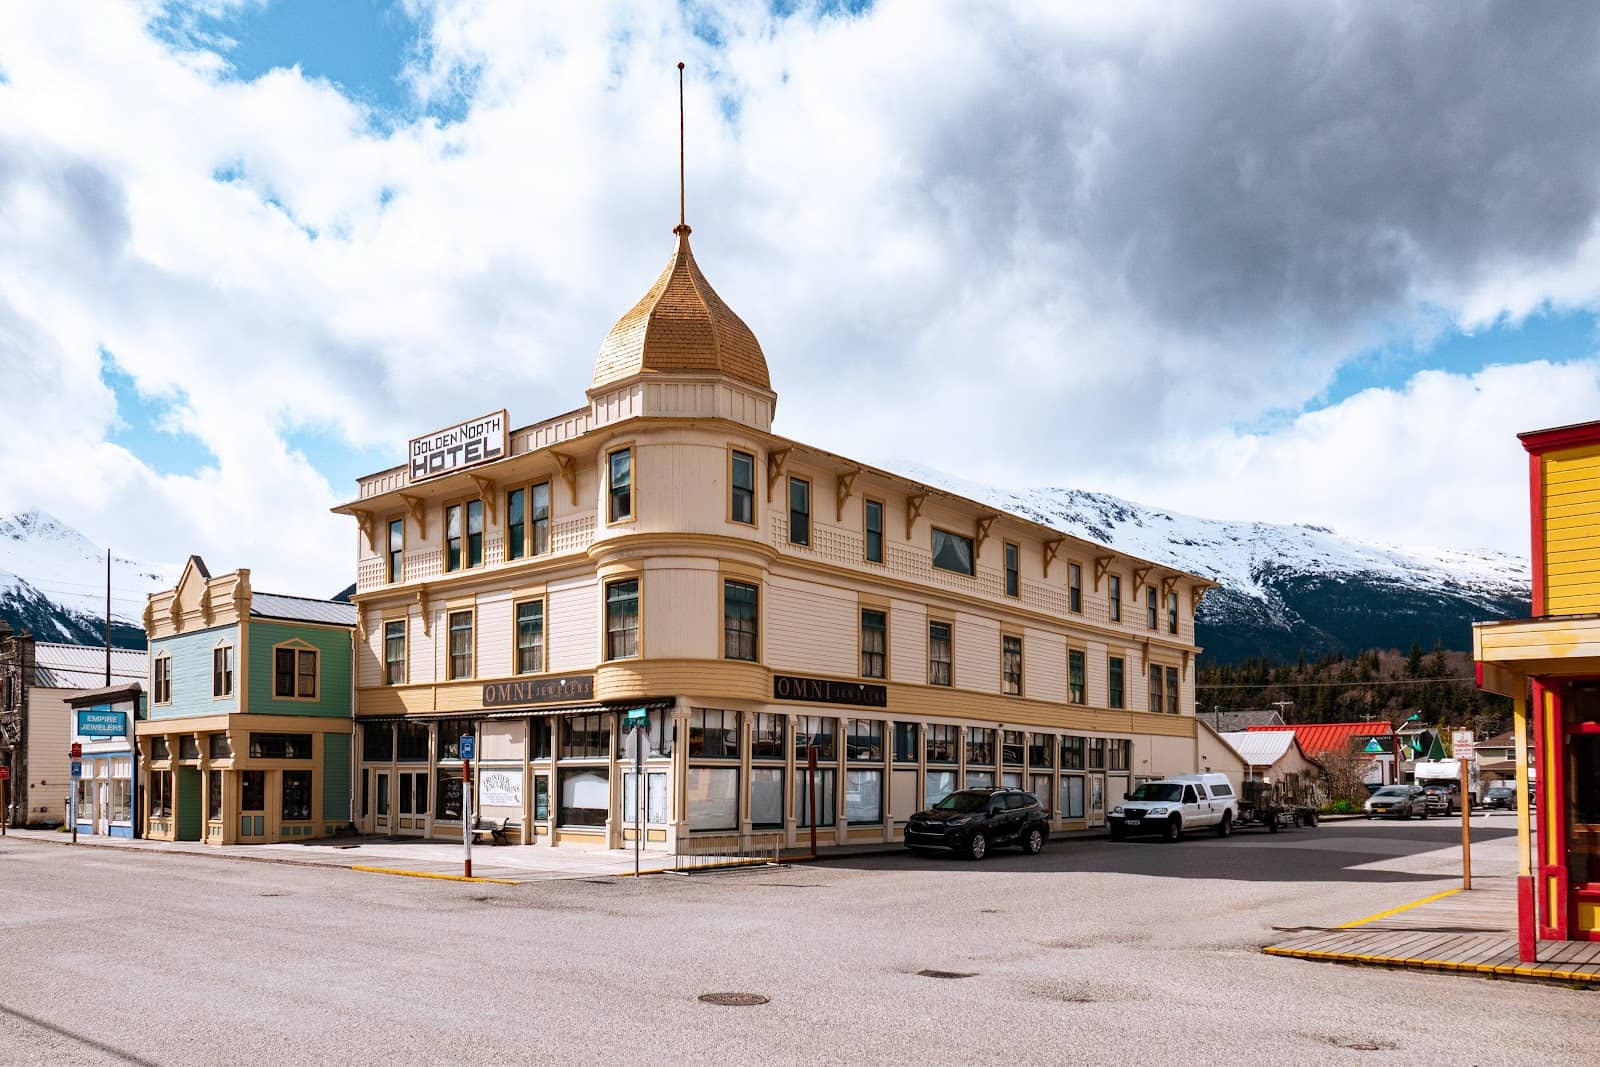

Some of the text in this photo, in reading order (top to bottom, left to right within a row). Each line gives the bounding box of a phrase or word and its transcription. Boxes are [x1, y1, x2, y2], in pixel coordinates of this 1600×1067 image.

[413, 417, 500, 456] GOLDEN NORTH
[412, 436, 501, 478] HOTEL
[485, 682, 590, 703] OMNI JEWELERS
[777, 677, 831, 700] OMNI
[80, 724, 123, 732] JEWELERS
[87, 715, 117, 723] EMPIRE
